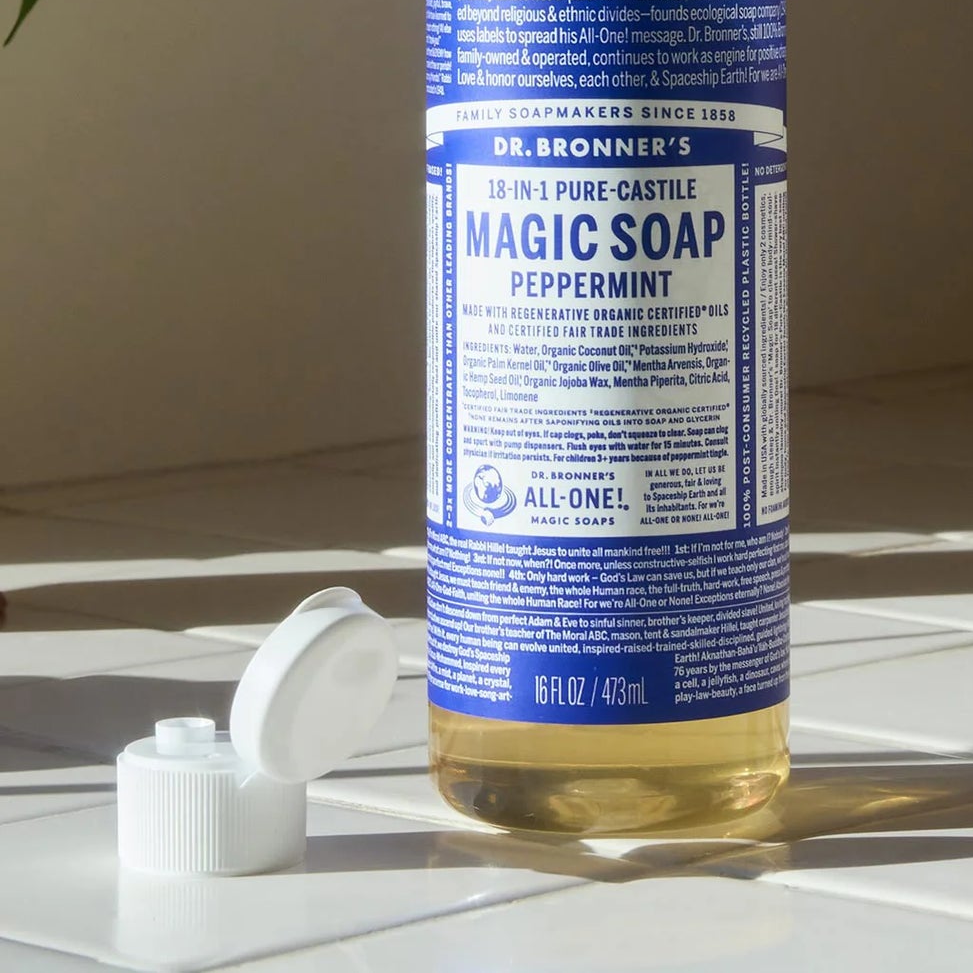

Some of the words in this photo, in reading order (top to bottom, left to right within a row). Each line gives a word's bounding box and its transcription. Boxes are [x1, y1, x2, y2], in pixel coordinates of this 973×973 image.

[457, 68, 476, 86] Love
[476, 68, 485, 86] &
[485, 69, 516, 87] honor
[517, 70, 577, 89] ourselves,
[579, 70, 609, 87] each
[611, 70, 648, 87] other,
[649, 69, 660, 86] &
[661, 68, 719, 90] Spaceship
[720, 66, 748, 85] Earth!
[456, 107, 502, 122] FAMILY
[508, 106, 633, 119] SOAPMAKERS
[641, 106, 695, 120] SINCE
[701, 108, 736, 122] 1858
[494, 136, 532, 157] DR.
[536, 136, 691, 158] BRONNER'S
[488, 179, 549, 201] 18-IN-1
[556, 178, 697, 201] PURE-CASTILE
[741, 163, 749, 220] BOTTLE!
[466, 210, 598, 261] MAGIC
[610, 210, 725, 261] SOAP
[741, 226, 750, 284] PLASTIC
[511, 270, 672, 299] PEPPERMINT
[462, 303, 483, 317] MADE
[485, 306, 508, 319] WITH
[510, 307, 589, 321] REGENERATIVE
[593, 307, 644, 321] ORGANIC
[708, 303, 729, 317] OILS
[488, 323, 505, 335] AND
[508, 323, 559, 338] CERTIFIED
[563, 325, 586, 338] FAIR
[590, 325, 624, 338] TRADE
[627, 322, 698, 338] INGREDIENTS
[741, 289, 750, 360] RECYCLED
[500, 390, 539, 403] Limonene
[742, 365, 751, 484] POST-CONSUMER
[531, 470, 548, 480] DR.
[550, 471, 615, 481] BRONNER'S
[743, 489, 751, 528] 100%
[531, 516, 569, 525] MAGIC
[574, 516, 615, 526] SOAPS
[535, 675, 548, 704] 16
[551, 676, 565, 705] FL
[568, 676, 585, 705] OZ
